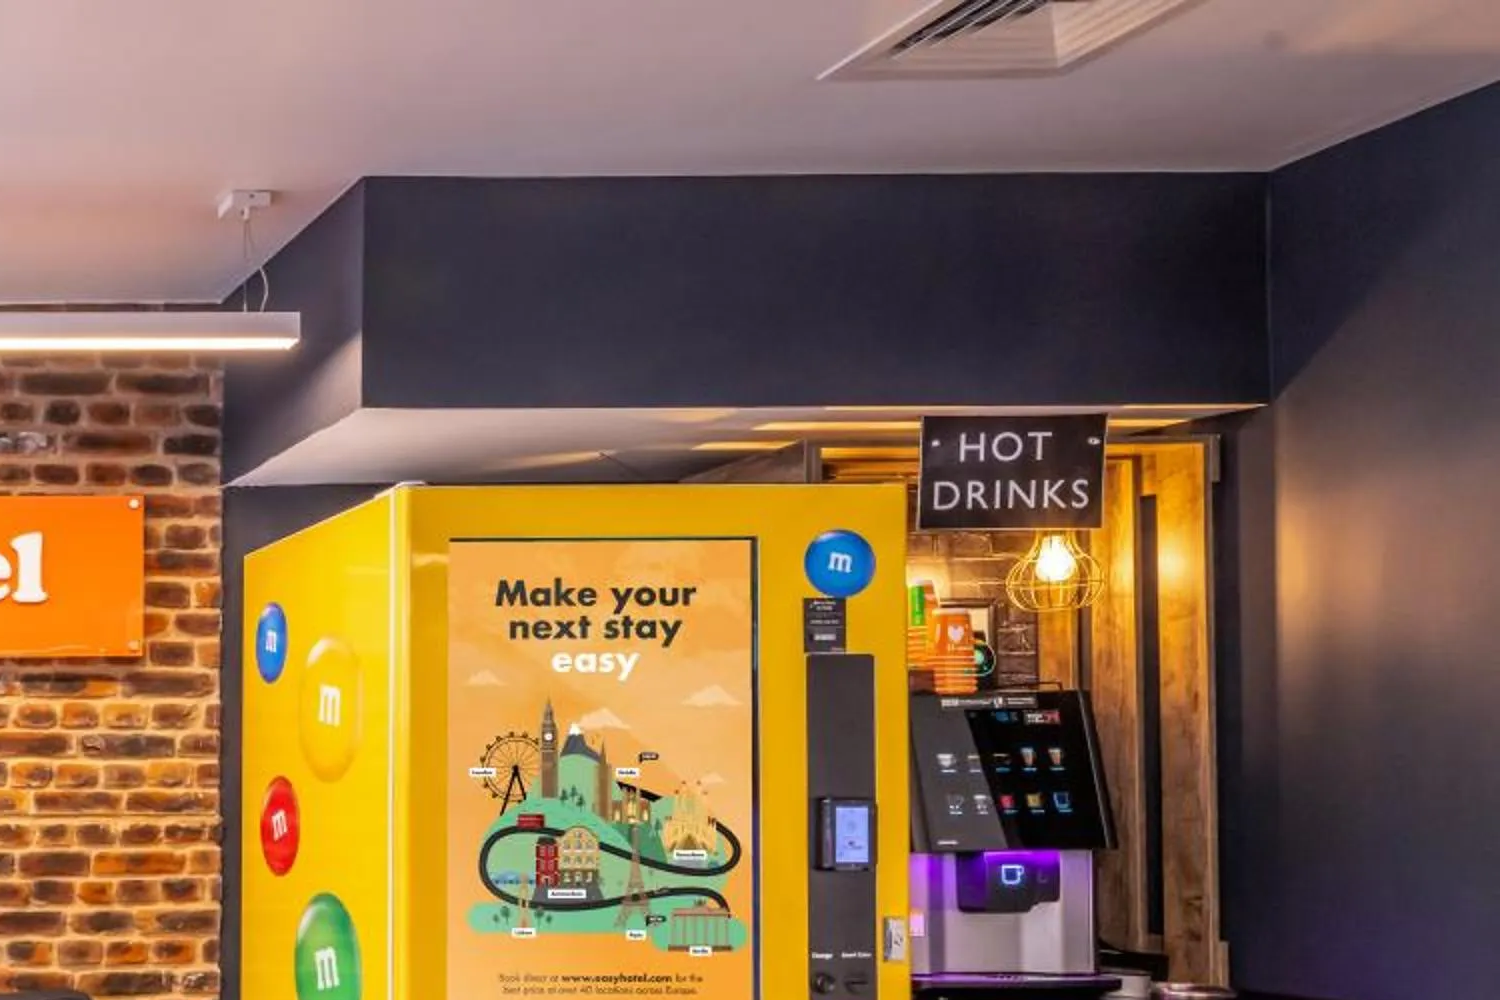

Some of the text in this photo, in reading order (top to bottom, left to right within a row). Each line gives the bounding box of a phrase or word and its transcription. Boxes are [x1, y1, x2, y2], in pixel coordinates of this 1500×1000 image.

[958, 431, 1053, 463] HOT
[932, 478, 1090, 511] DRINKS
[827, 550, 853, 573] m
[494, 577, 697, 615] Make your
[265, 629, 278, 653] m
[509, 615, 683, 648] next stay
[550, 651, 641, 681] easy
[317, 683, 342, 727] m
[270, 808, 289, 842] m
[313, 945, 340, 992] m
[561, 972, 673, 985] www.easyhotel.com
